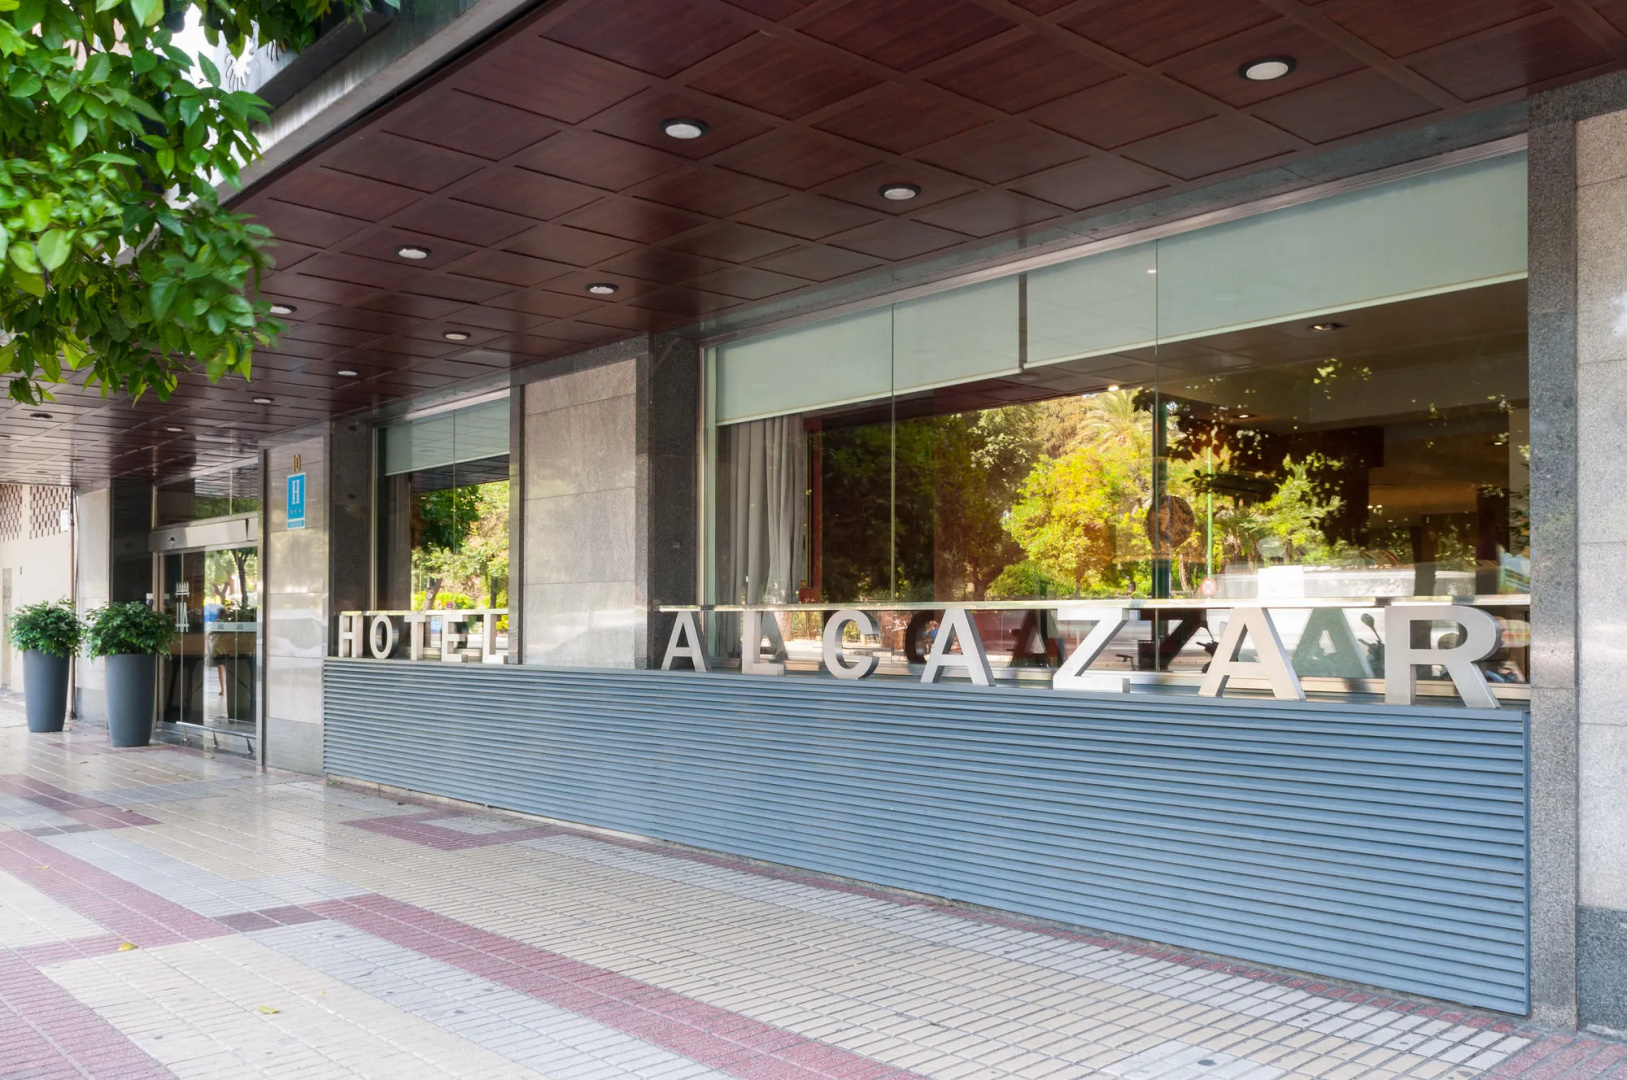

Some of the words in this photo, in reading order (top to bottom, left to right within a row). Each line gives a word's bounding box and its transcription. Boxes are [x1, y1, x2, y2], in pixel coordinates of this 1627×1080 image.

[291, 480, 301, 504] H
[338, 613, 508, 665] HOTEL
[660, 606, 1500, 708] ALCAZAR
